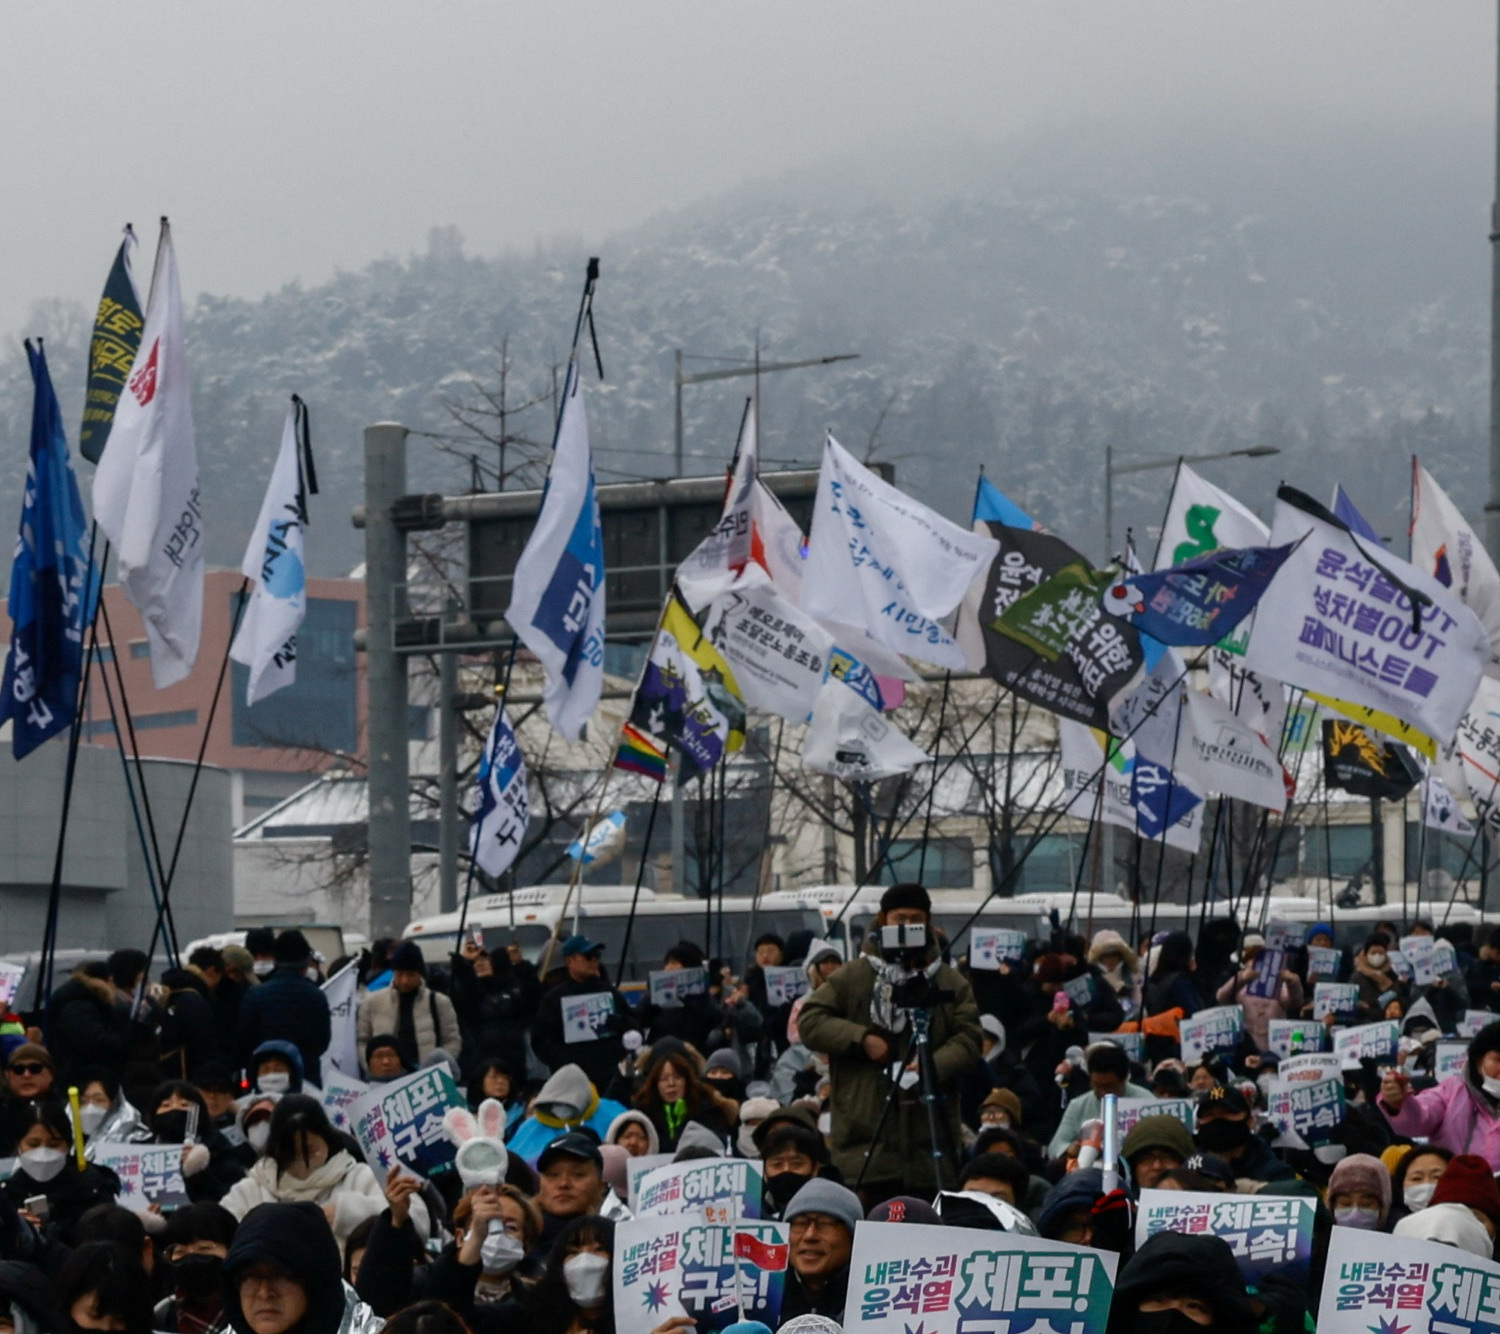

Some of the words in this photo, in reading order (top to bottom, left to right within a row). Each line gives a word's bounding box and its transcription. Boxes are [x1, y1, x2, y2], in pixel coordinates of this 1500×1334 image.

[382, 1067, 448, 1124] 체포!
[1290, 1078, 1338, 1113] 체포!
[1293, 1101, 1342, 1135] 구속!
[683, 1163, 748, 1199] 해체
[1146, 1204, 1212, 1226] 내란수괴
[1211, 1199, 1303, 1234] 체포!
[622, 1231, 680, 1264] 내란수괴
[621, 1248, 678, 1288] 윤석열
[863, 1252, 958, 1289] 내란수괴
[956, 1249, 1096, 1317] 체포!
[1340, 1260, 1431, 1286] 내란수괴
[860, 1276, 956, 1321] 윤석열
[1337, 1279, 1428, 1313] 윤석열
